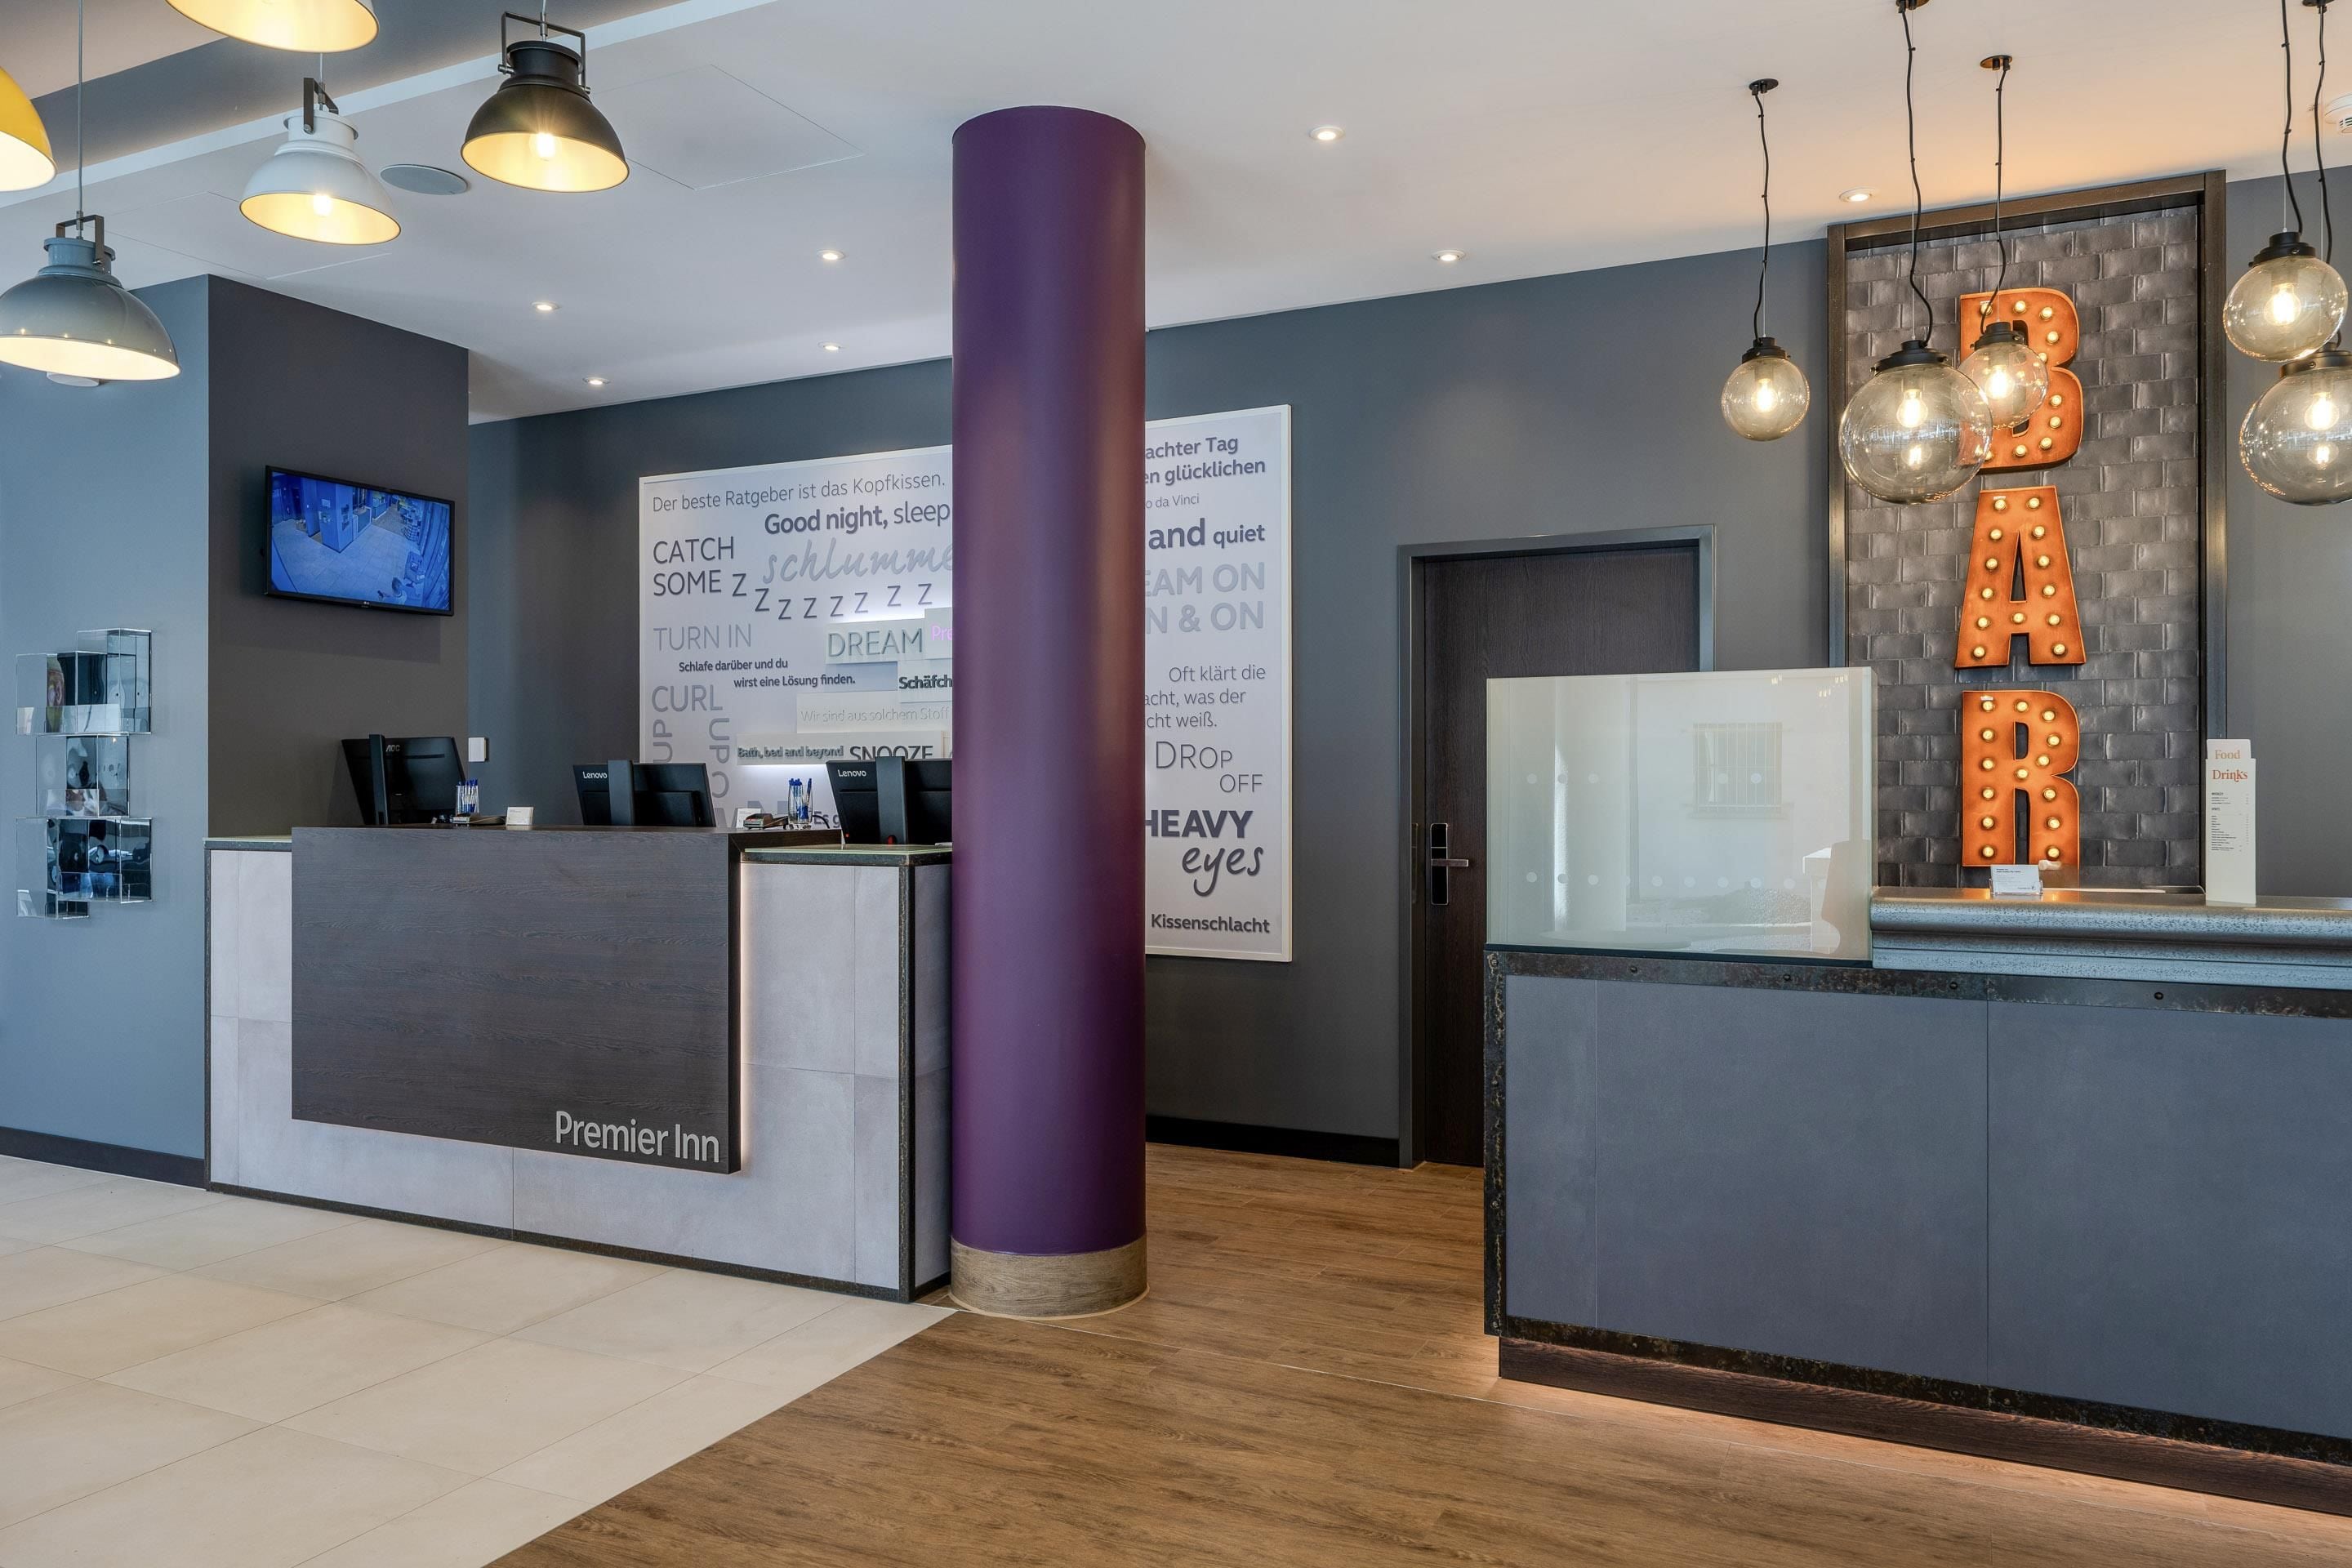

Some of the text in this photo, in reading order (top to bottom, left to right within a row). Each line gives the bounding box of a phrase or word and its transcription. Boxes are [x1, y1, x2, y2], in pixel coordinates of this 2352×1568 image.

[1205, 436, 1238, 454] Tag
[1165, 459, 1266, 486] glücklichen
[653, 473, 945, 512] Der beste Ratgeber ist das Kopfkissen.
[1156, 497, 1169, 507] da
[1172, 493, 1200, 506] Vinci
[764, 501, 951, 534] Good night, sleep
[1148, 517, 1265, 550] and quiet
[653, 536, 734, 564] CATCH
[653, 569, 723, 597] SOME
[1212, 561, 1265, 593] ON
[1954, 286, 2086, 871] BAR
[1178, 604, 1201, 633] &
[1210, 601, 1263, 630] ON
[653, 623, 752, 652] TURN IN
[828, 627, 923, 657] DREAM
[679, 657, 788, 672] Schlafe darüber und du
[1169, 664, 1266, 683] Oft klärt die
[733, 673, 856, 689] wirst eine Lösung finden.
[652, 684, 723, 712] CURL
[1184, 692, 1214, 705] was
[1219, 688, 1246, 704] der
[800, 706, 950, 722] Wir sind aus solchem Stoff
[1175, 711, 1217, 728] weiß.
[764, 746, 784, 758] bed
[785, 746, 804, 758] and
[805, 745, 844, 759] beyond
[1156, 741, 1233, 769] DROP
[2214, 749, 2241, 760] Food
[582, 771, 608, 779] Lenovo
[837, 769, 867, 777] Lenovo
[1219, 773, 1263, 793] OFF
[2212, 768, 2248, 782] Drinks
[1182, 846, 1263, 897] eyes
[1151, 913, 1270, 933] Kissenschlacht
[555, 1110, 719, 1163] Premier Inn
